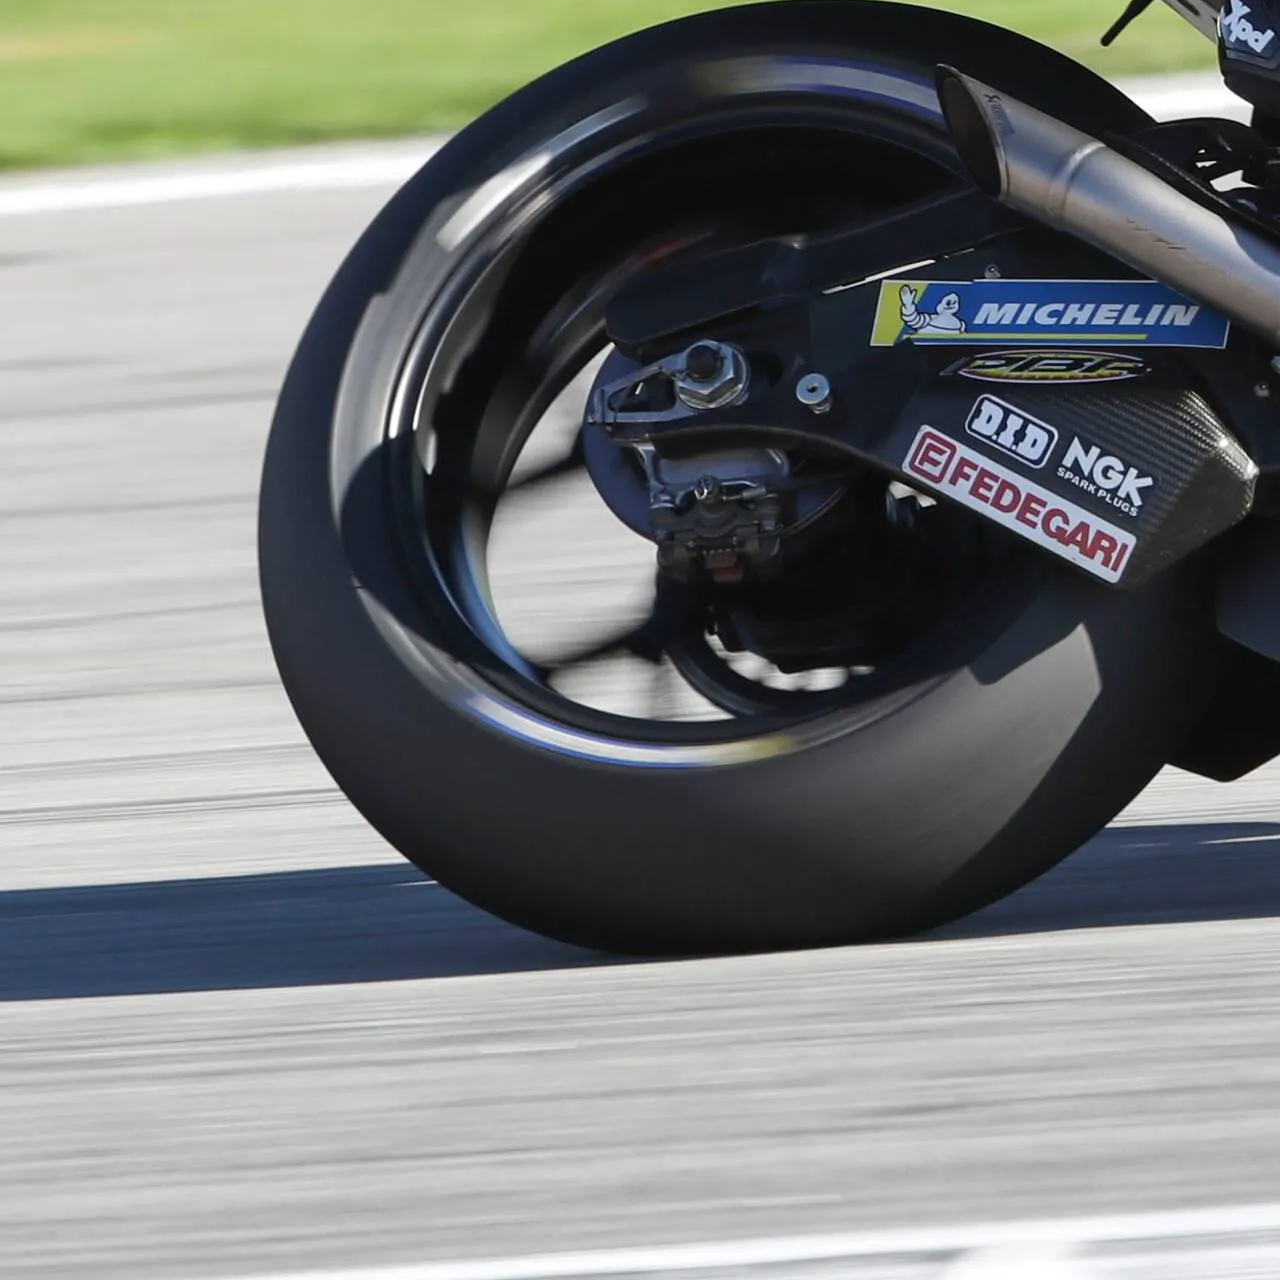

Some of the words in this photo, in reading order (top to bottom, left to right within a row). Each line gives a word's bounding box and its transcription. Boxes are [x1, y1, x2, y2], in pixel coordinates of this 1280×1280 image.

[972, 302, 1200, 327] MICHELIN
[970, 399, 1050, 461] D.I.D
[1056, 466, 1097, 495] SPARK
[1096, 488, 1139, 518] PLUGS
[1061, 435, 1154, 508] NGK
[949, 455, 1129, 573] FEDEGARI
